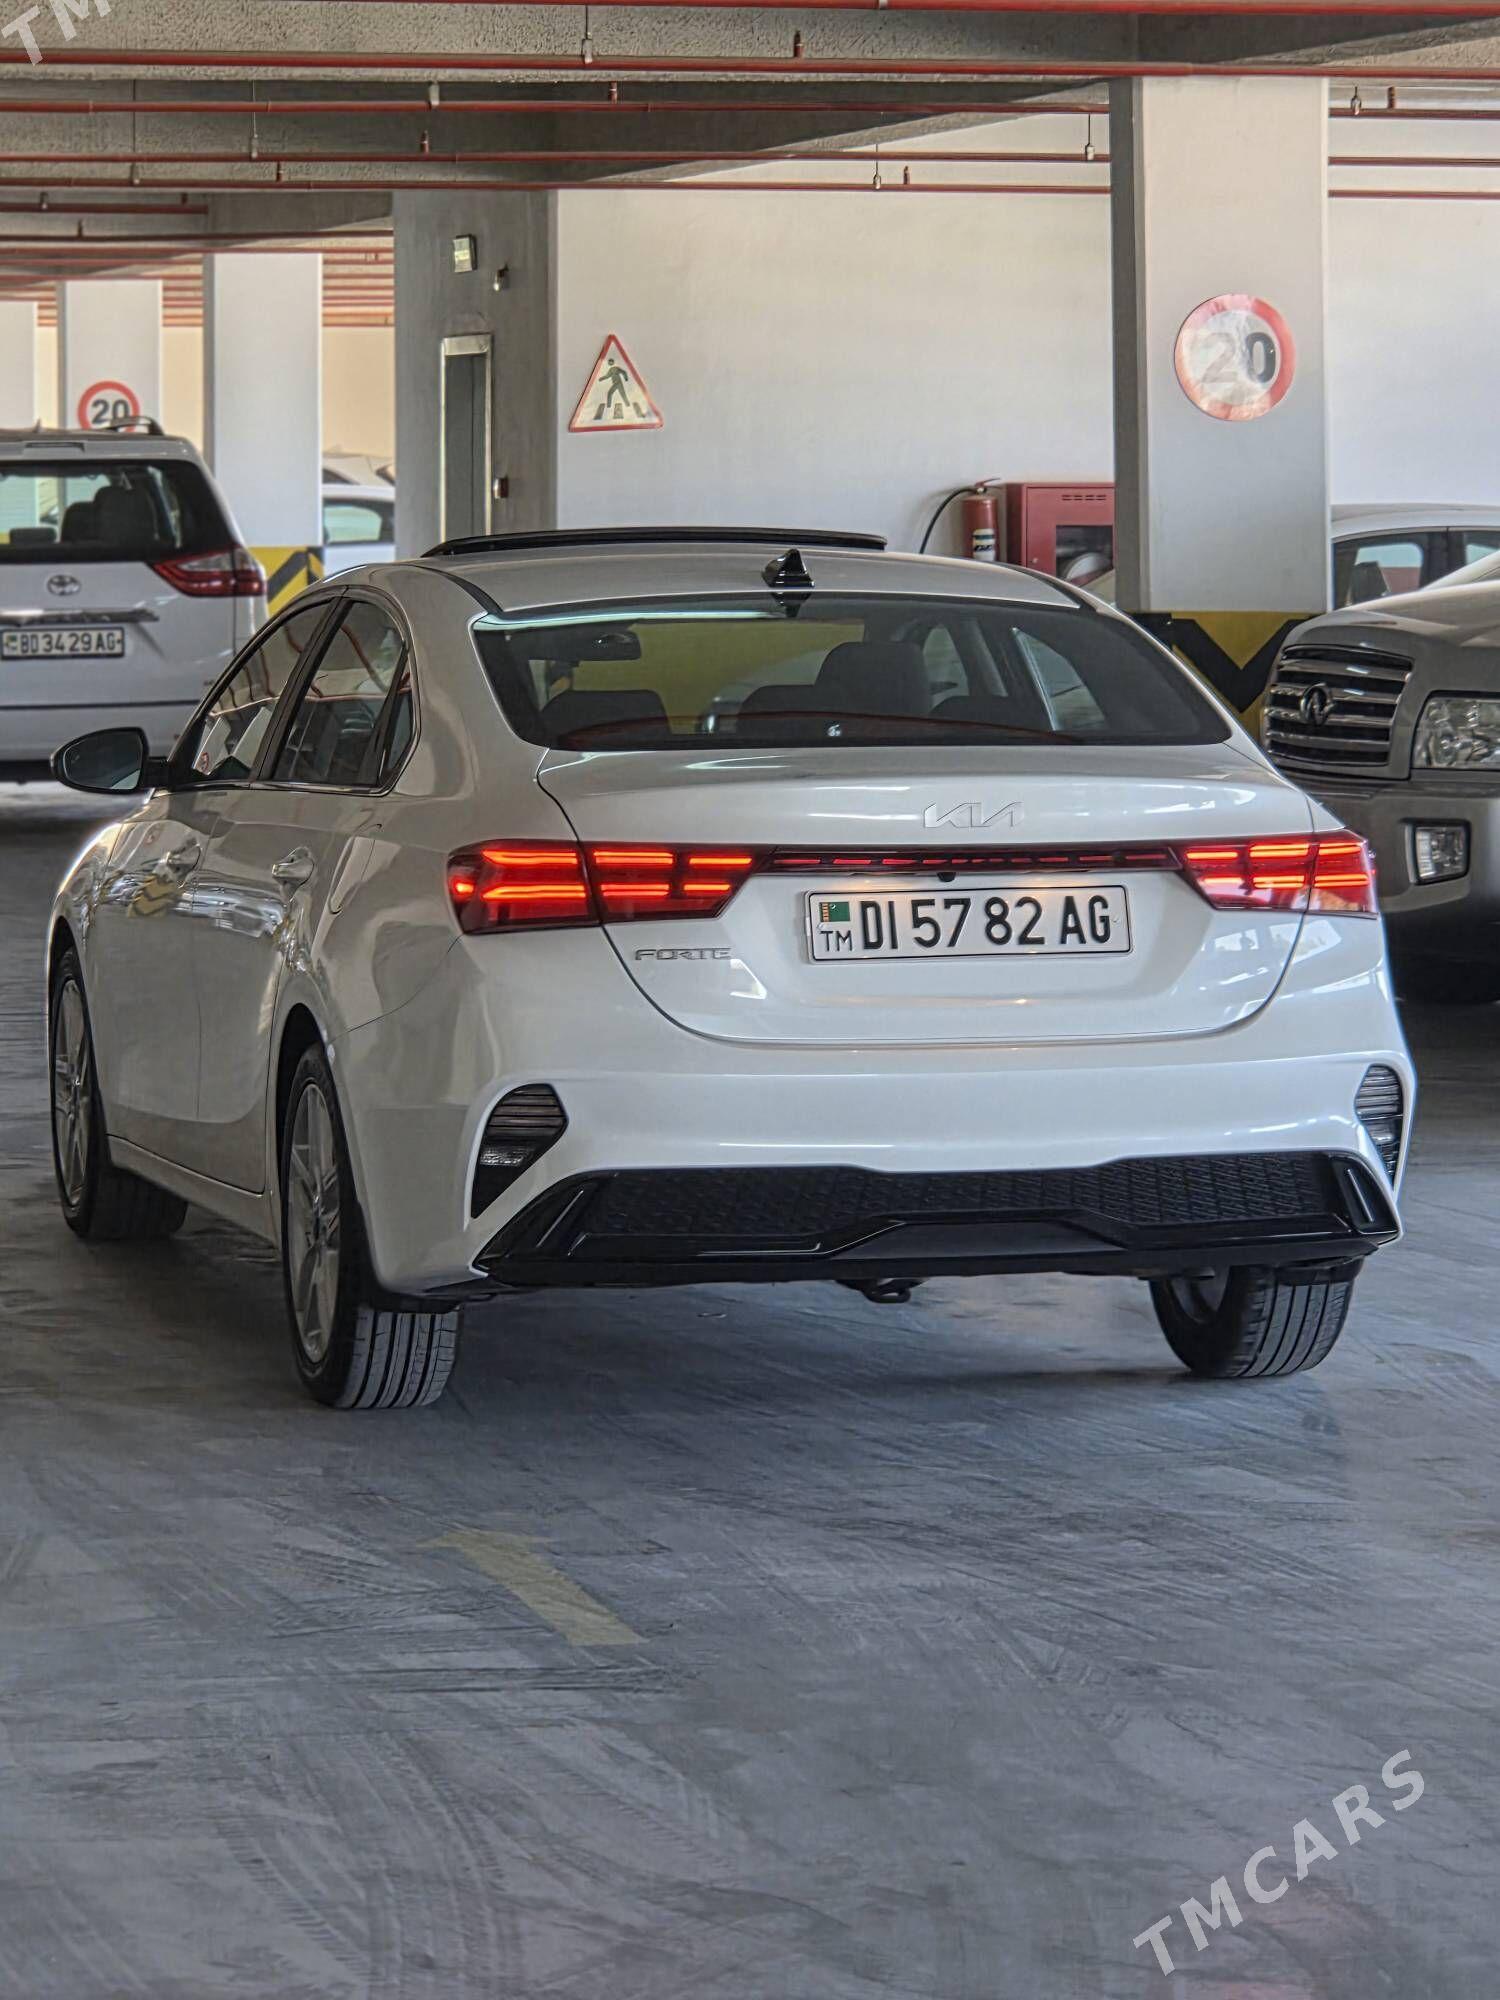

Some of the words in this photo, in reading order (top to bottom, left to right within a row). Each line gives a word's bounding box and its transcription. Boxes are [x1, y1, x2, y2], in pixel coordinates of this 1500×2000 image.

[1197, 331, 1276, 384] 20
[92, 399, 130, 424] 20
[911, 898, 971, 948] 57
[985, 896, 1045, 945] 82
[1060, 895, 1111, 944] AG
[820, 930, 853, 952] TM
[635, 948, 732, 961] FORTE
